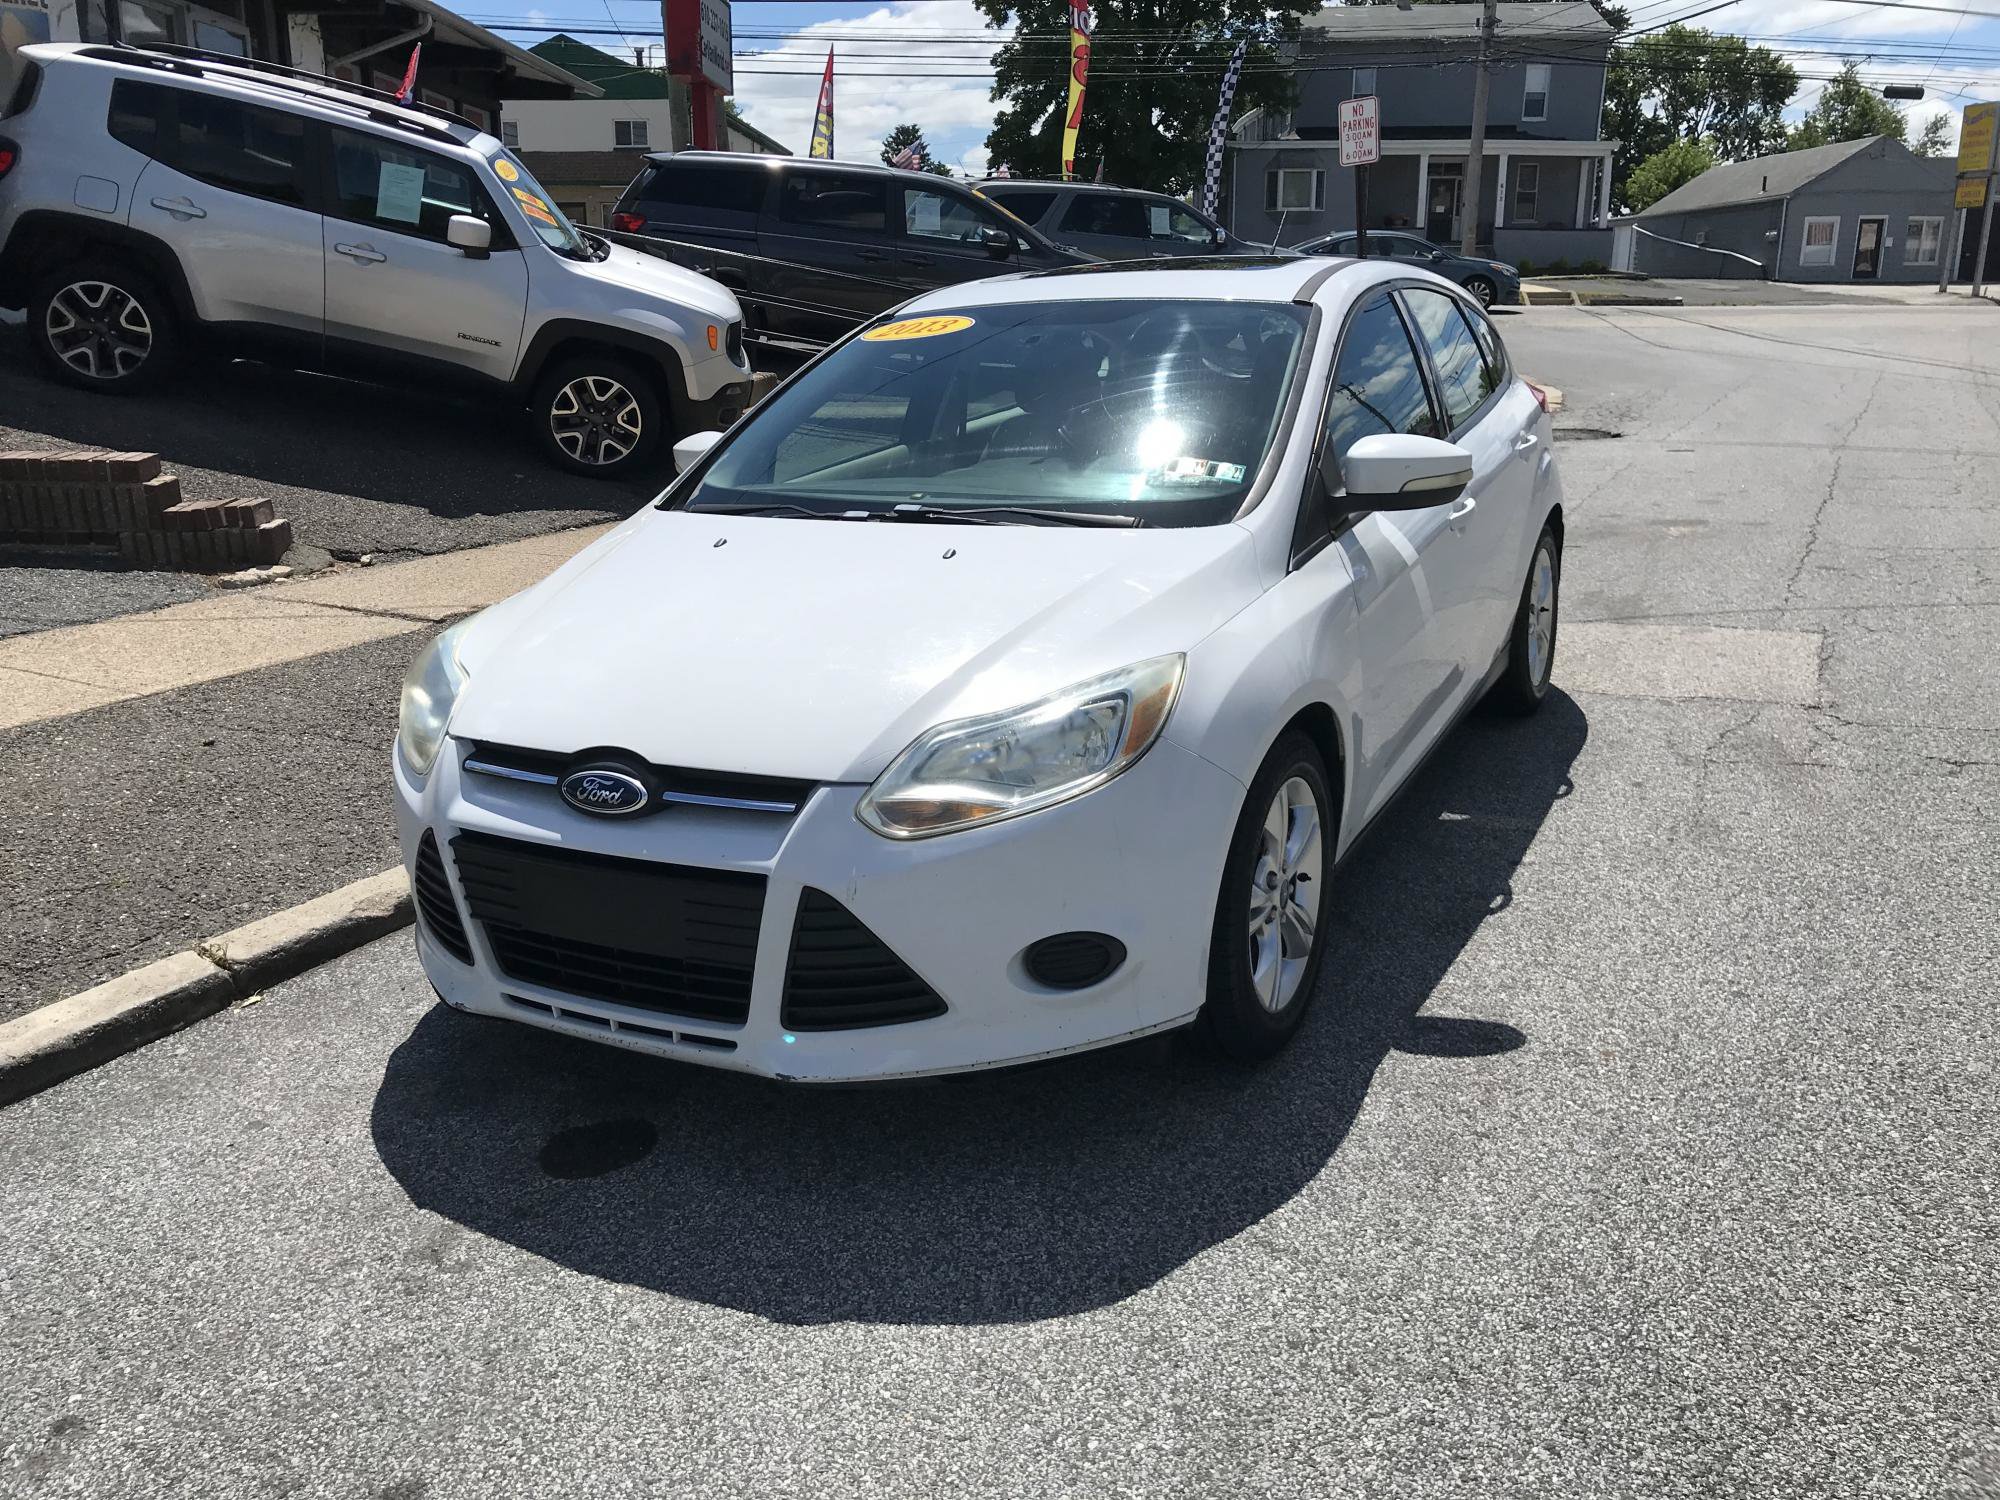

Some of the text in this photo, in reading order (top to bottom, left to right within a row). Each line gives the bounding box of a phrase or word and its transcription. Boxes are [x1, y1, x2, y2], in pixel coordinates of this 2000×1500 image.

[1352, 104, 1364, 117] NO
[1343, 117, 1375, 132] PARKING
[1354, 140, 1364, 150] TO
[873, 319, 960, 338] 2013
[577, 777, 625, 804] Ford
